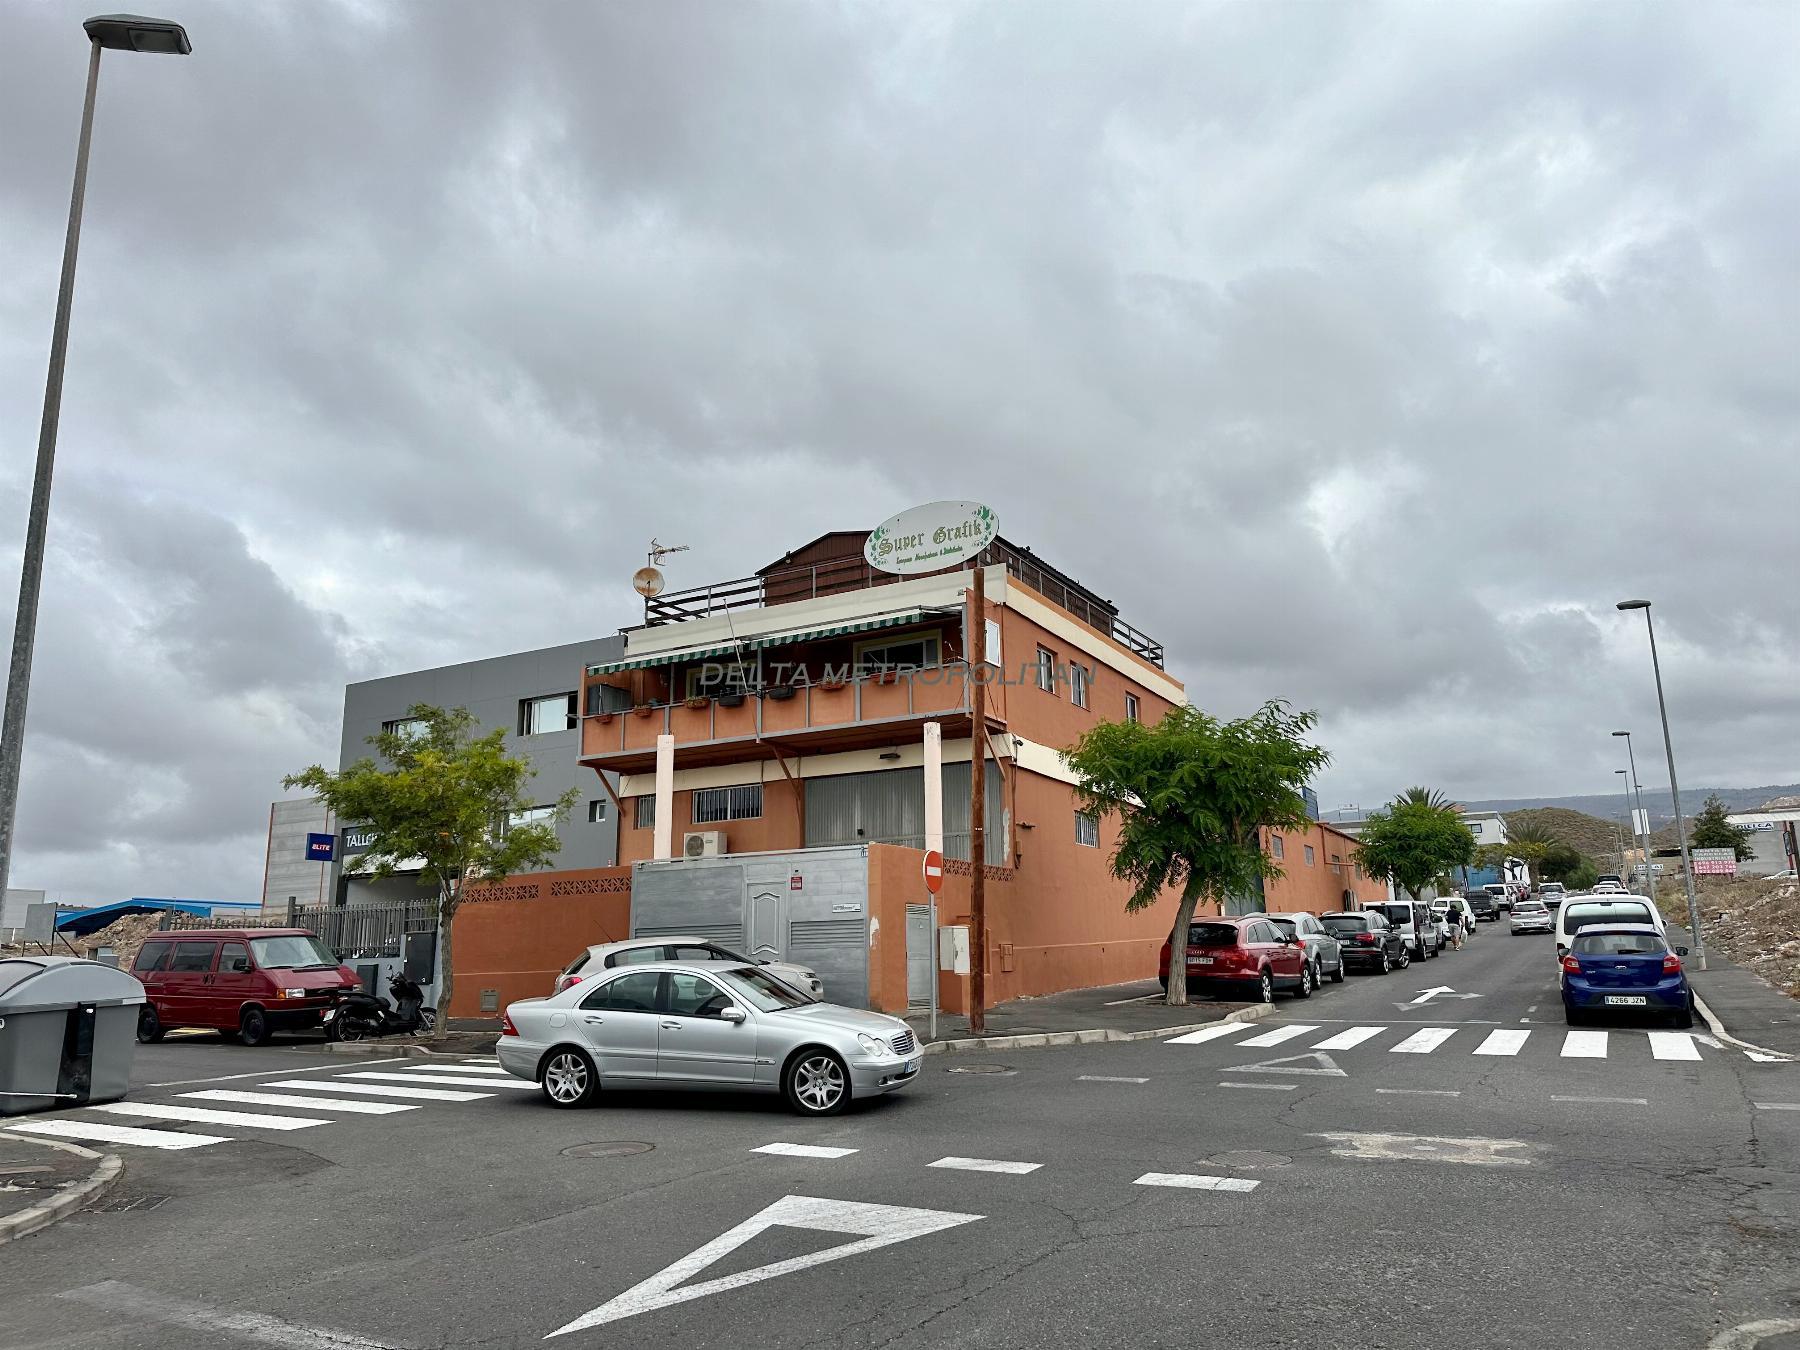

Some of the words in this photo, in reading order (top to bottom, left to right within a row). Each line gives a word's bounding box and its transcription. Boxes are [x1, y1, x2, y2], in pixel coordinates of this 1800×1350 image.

[879, 533, 925, 557] Super
[933, 520, 983, 544] Grafik
[312, 843, 331, 851] ELITE
